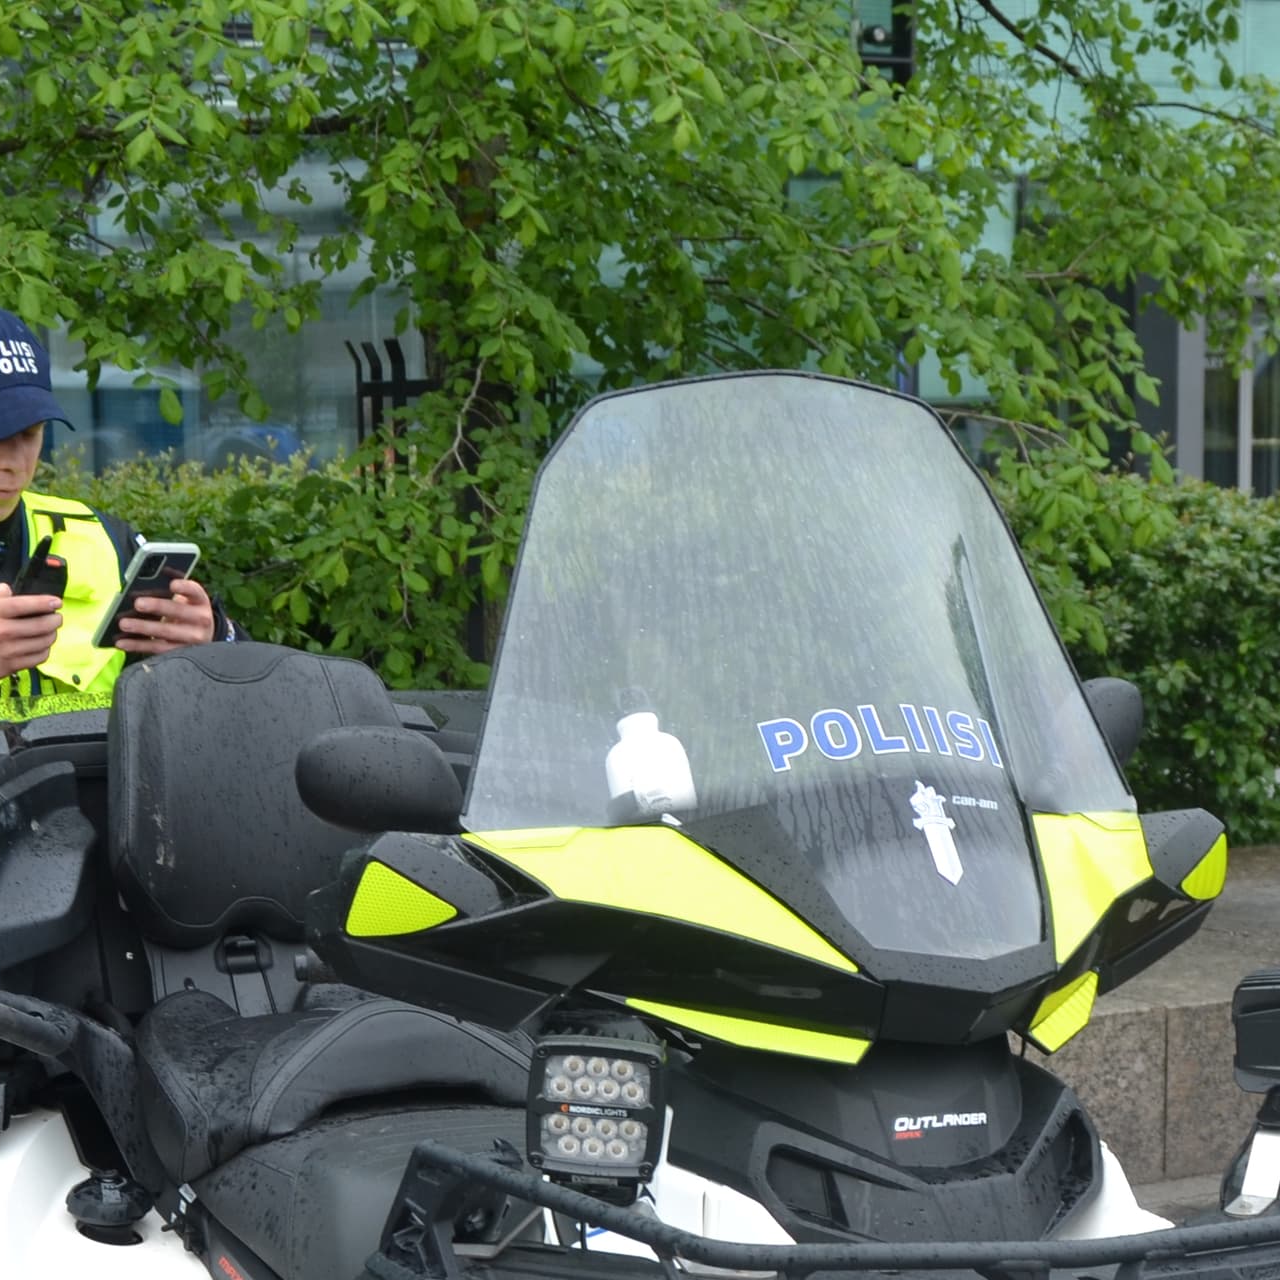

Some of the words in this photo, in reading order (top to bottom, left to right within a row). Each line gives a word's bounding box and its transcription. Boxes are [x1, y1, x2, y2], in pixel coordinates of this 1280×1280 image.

[757, 703, 1004, 773] POLIISI
[951, 795, 999, 810] can-am
[894, 1112, 987, 1132] OUTLANDER
